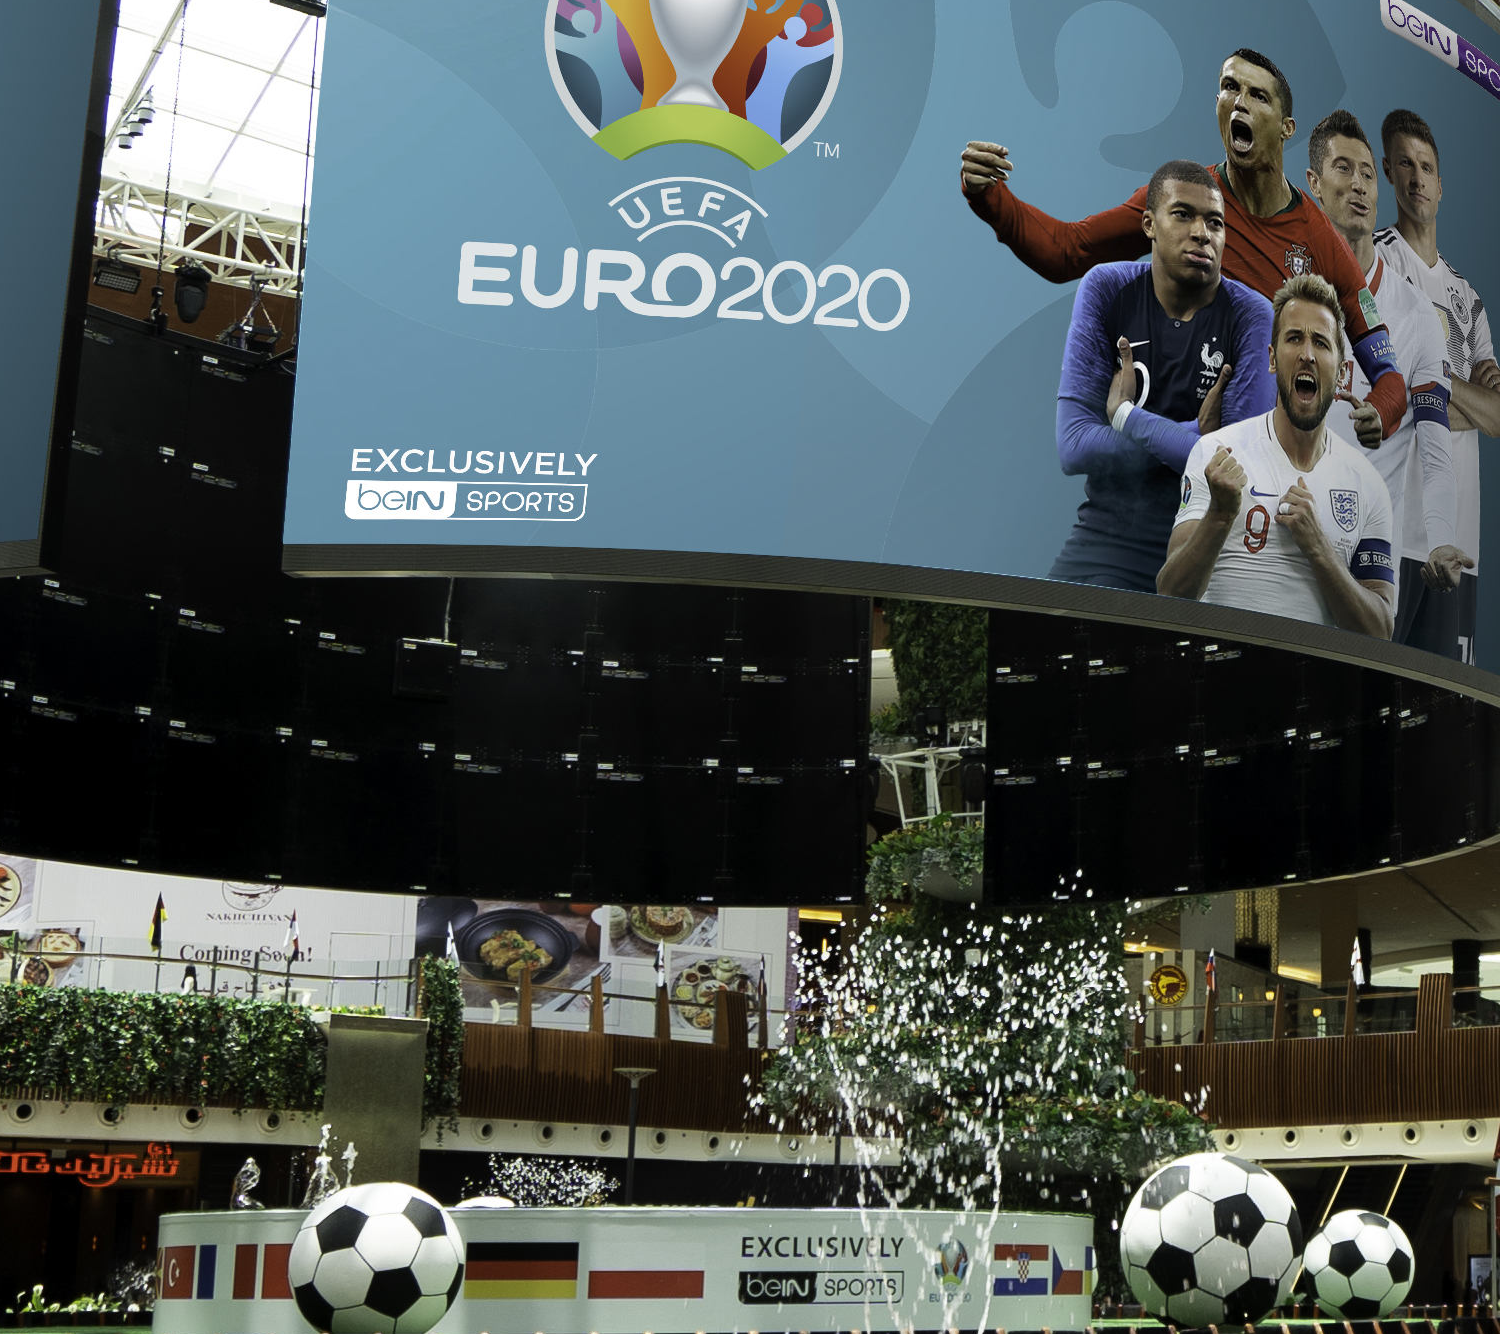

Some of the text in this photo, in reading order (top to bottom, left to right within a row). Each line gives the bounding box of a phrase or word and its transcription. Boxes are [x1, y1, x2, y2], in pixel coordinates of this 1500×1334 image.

[813, 141, 840, 159] TM
[616, 185, 755, 241] UEFA
[1416, 394, 1445, 409] RESPECT
[350, 447, 599, 478] EXCLUSIVELY
[465, 489, 576, 515] SPORTS
[1243, 504, 1271, 554] 9
[824, 1277, 898, 1298] SPORTS
